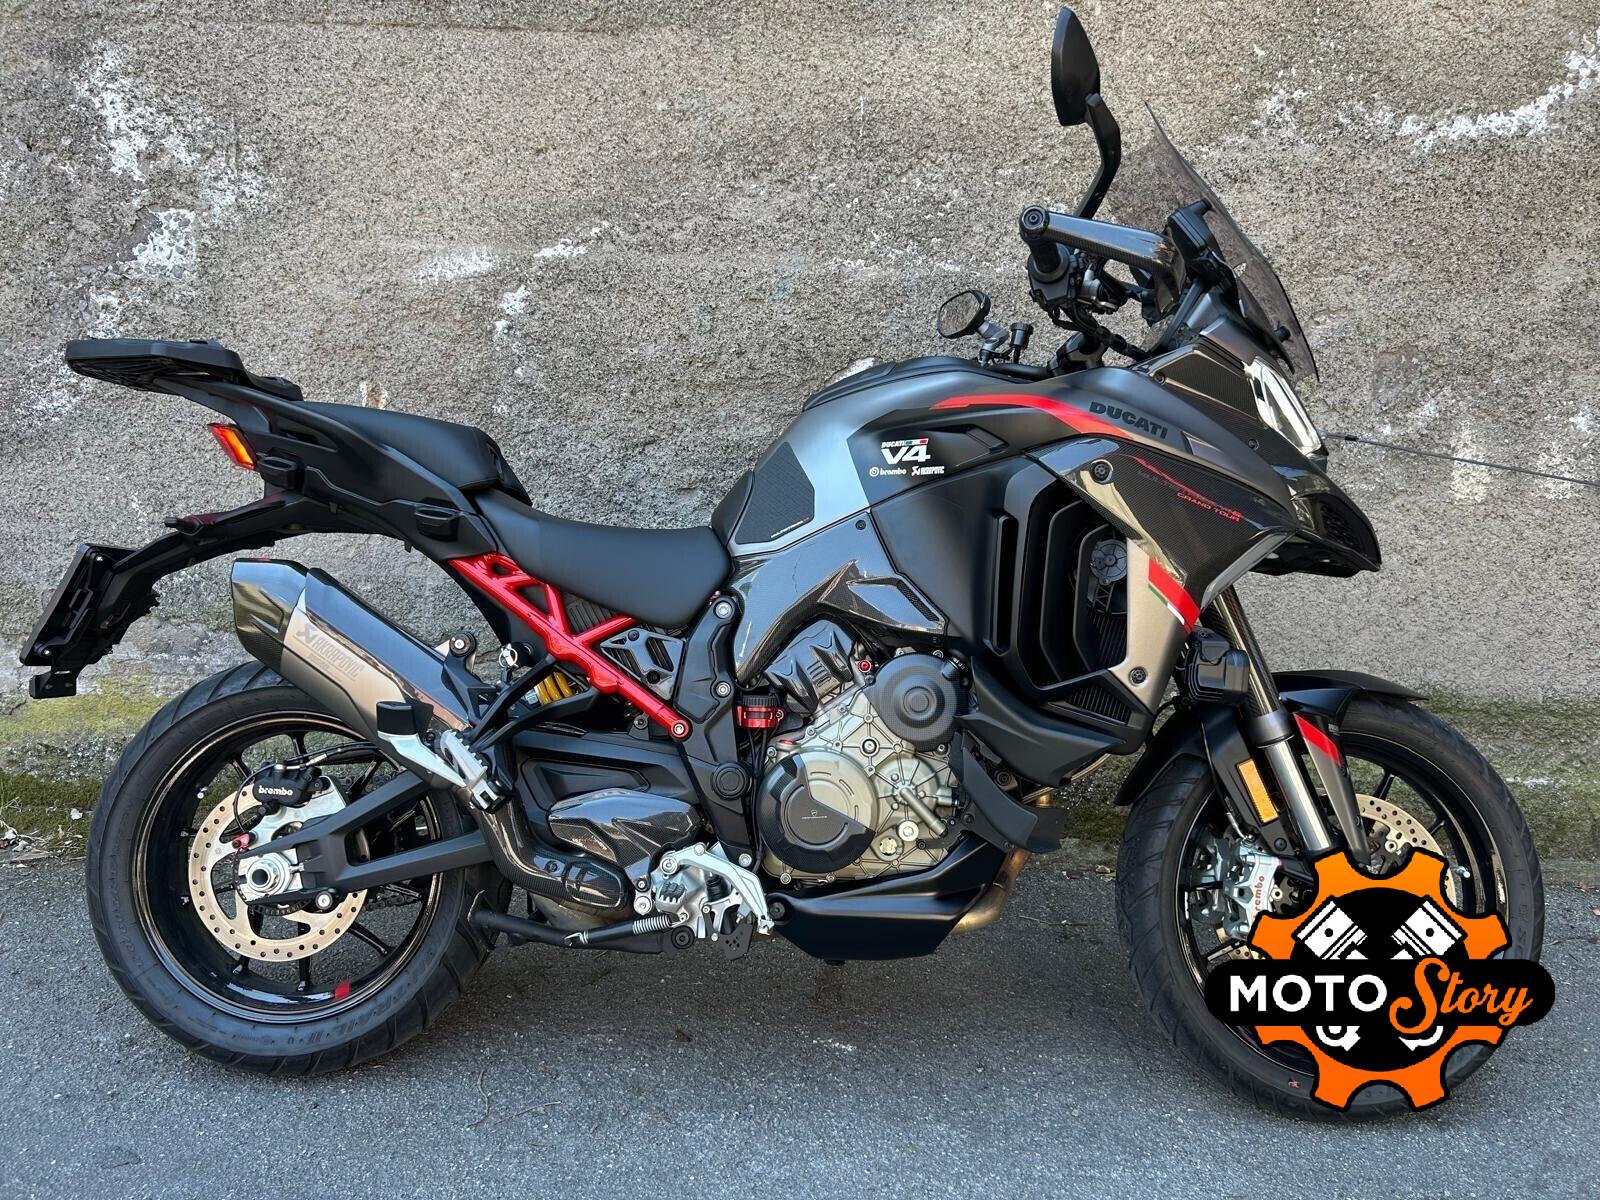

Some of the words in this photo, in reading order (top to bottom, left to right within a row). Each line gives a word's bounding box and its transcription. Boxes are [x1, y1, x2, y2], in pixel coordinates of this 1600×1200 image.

[1089, 401, 1168, 439] DUCATI
[881, 440, 905, 448] DUCATI
[881, 444, 931, 465] V4
[880, 467, 907, 476] brembo
[1177, 492, 1212, 511] GRAND
[1214, 506, 1240, 522] TOUR
[258, 784, 294, 796] brembo
[1252, 875, 1265, 919] rembo
